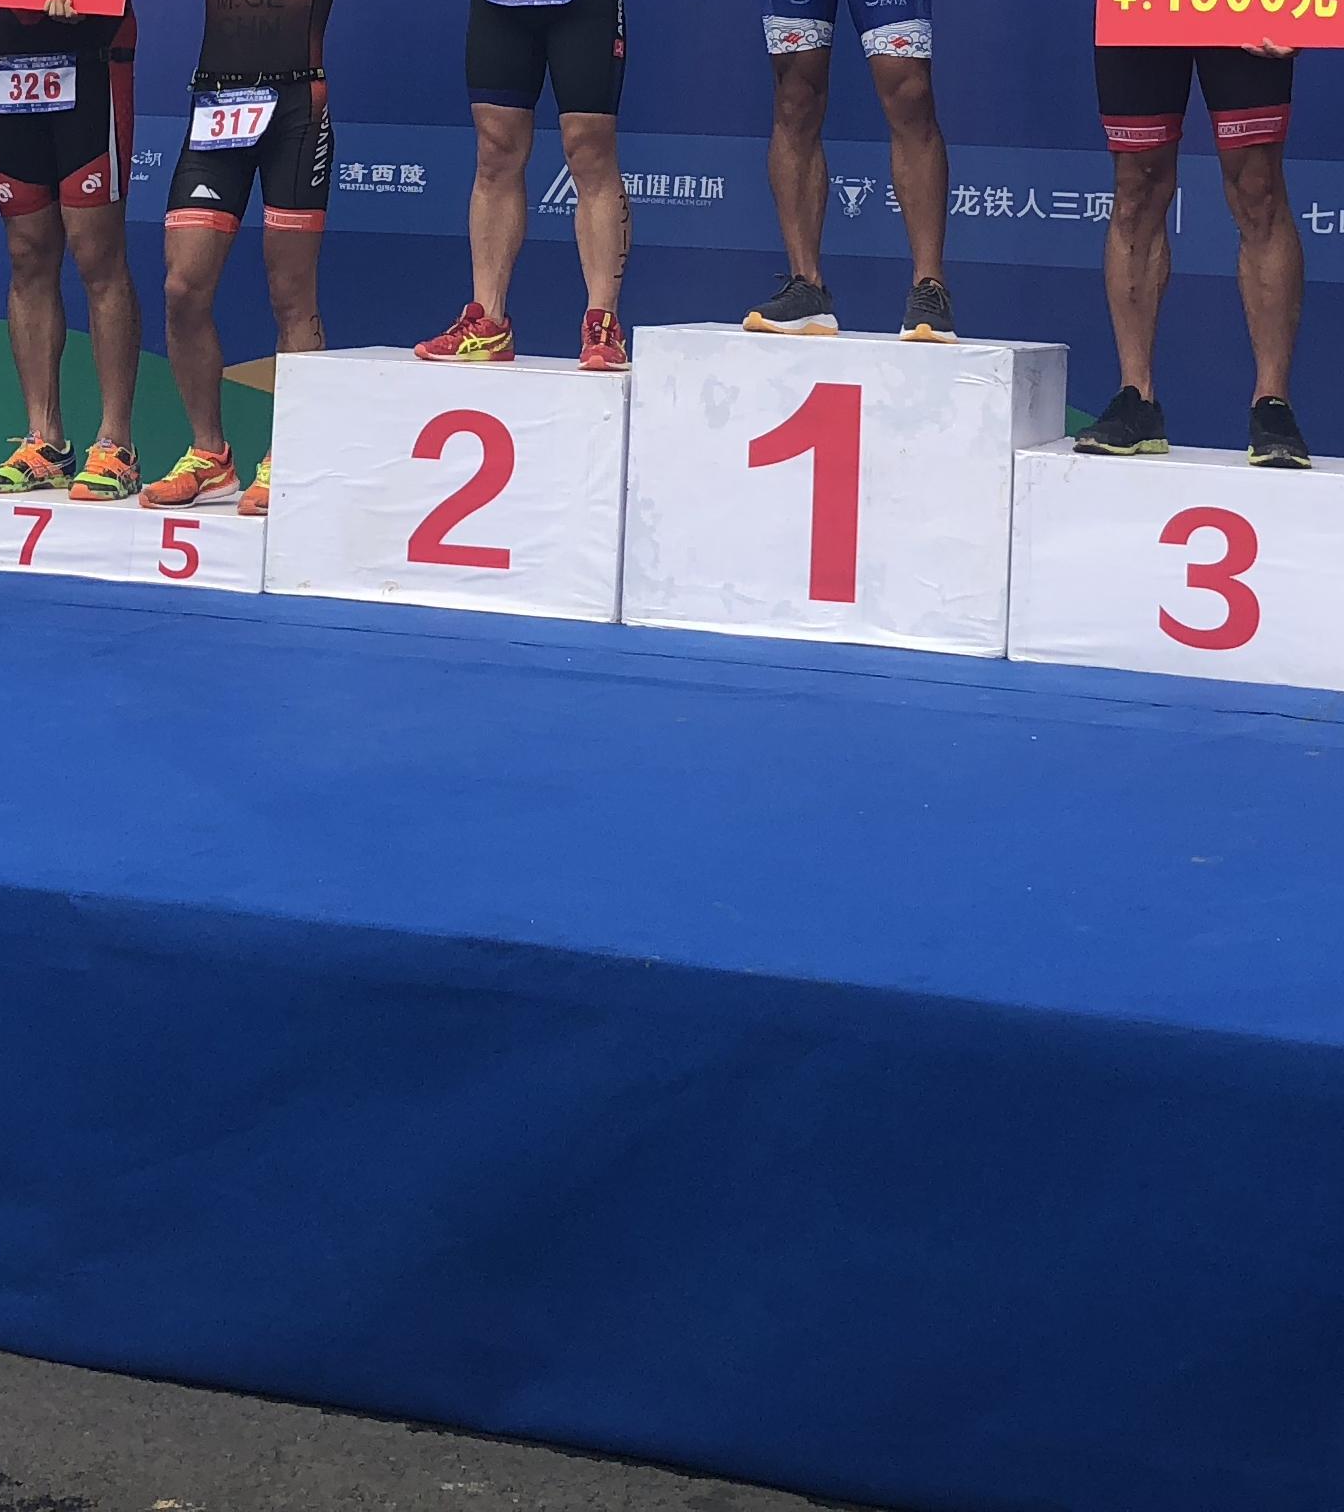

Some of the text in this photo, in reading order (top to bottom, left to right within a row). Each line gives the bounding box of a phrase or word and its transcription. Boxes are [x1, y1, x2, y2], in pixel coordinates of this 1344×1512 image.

[9, 71, 62, 101] 326
[210, 106, 264, 138] 317
[407, 409, 516, 570] 2
[748, 382, 863, 603] 1
[13, 507, 54, 566] 7
[158, 520, 201, 580] 5
[1158, 506, 1261, 650] 3
